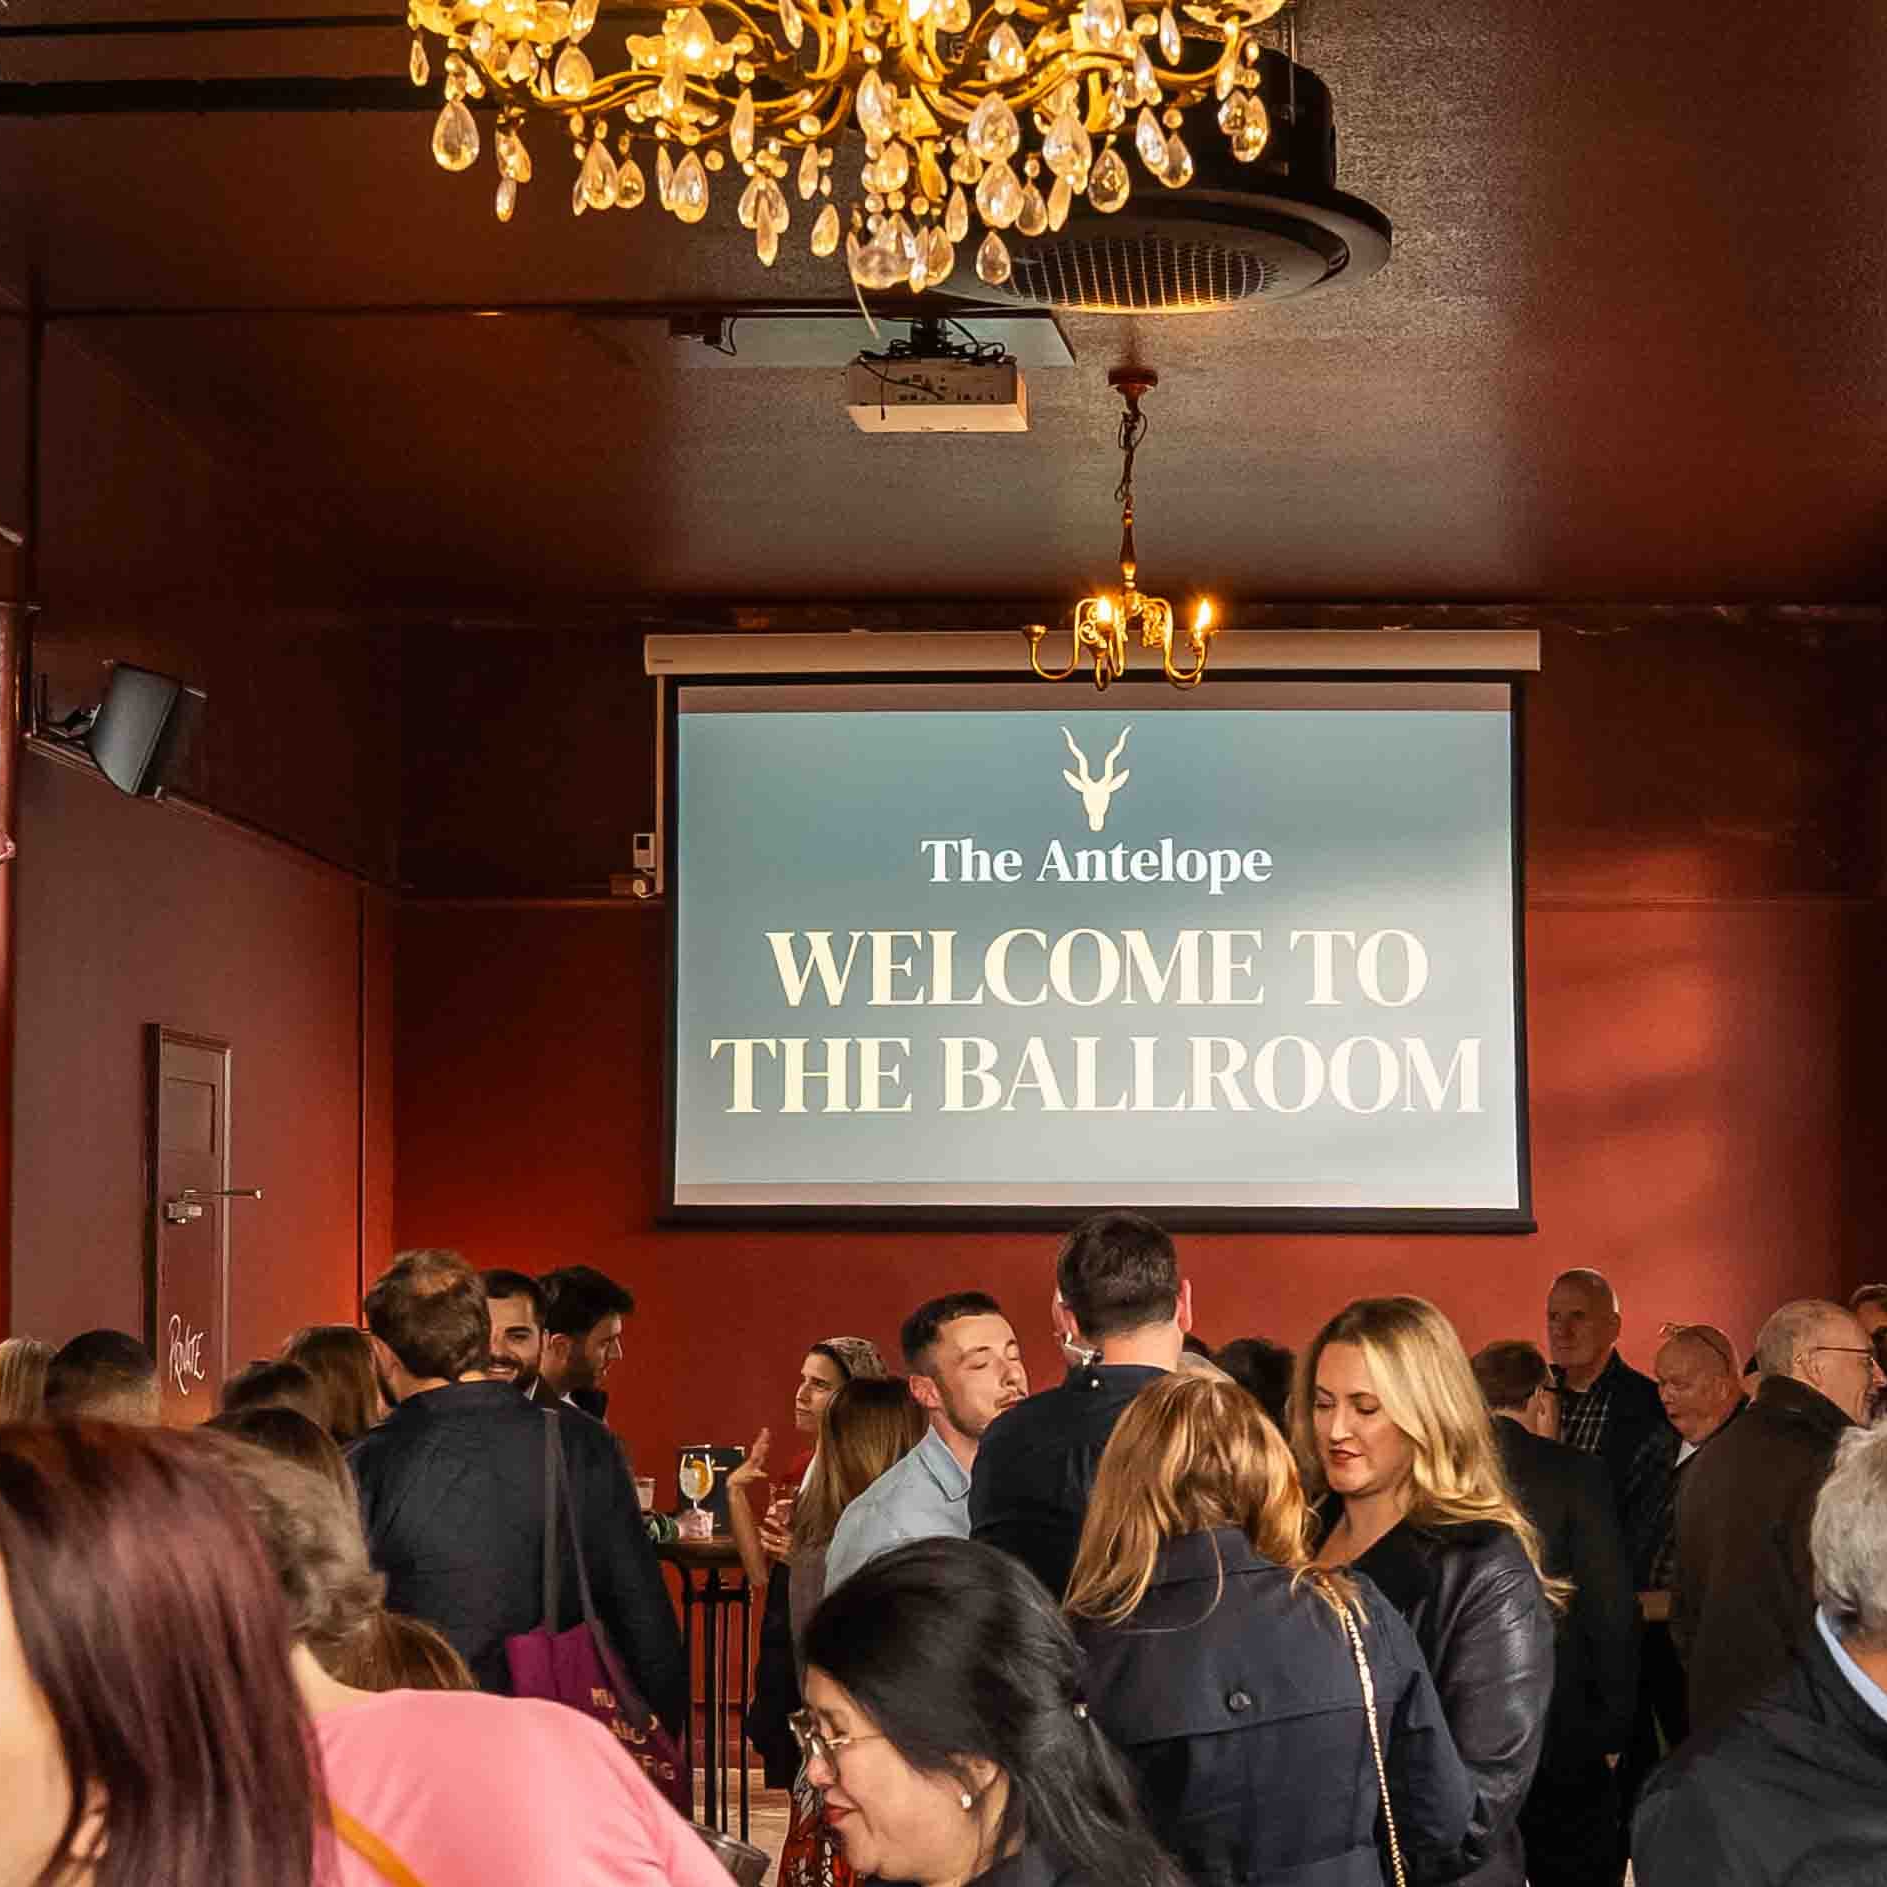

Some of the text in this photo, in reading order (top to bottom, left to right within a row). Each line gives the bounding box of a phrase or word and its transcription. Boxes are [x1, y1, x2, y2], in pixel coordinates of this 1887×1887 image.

[921, 838, 1274, 896] The Antelope
[765, 928, 1429, 1008] WELCOME TO
[710, 1035, 1484, 1115] THE BALLROOM
